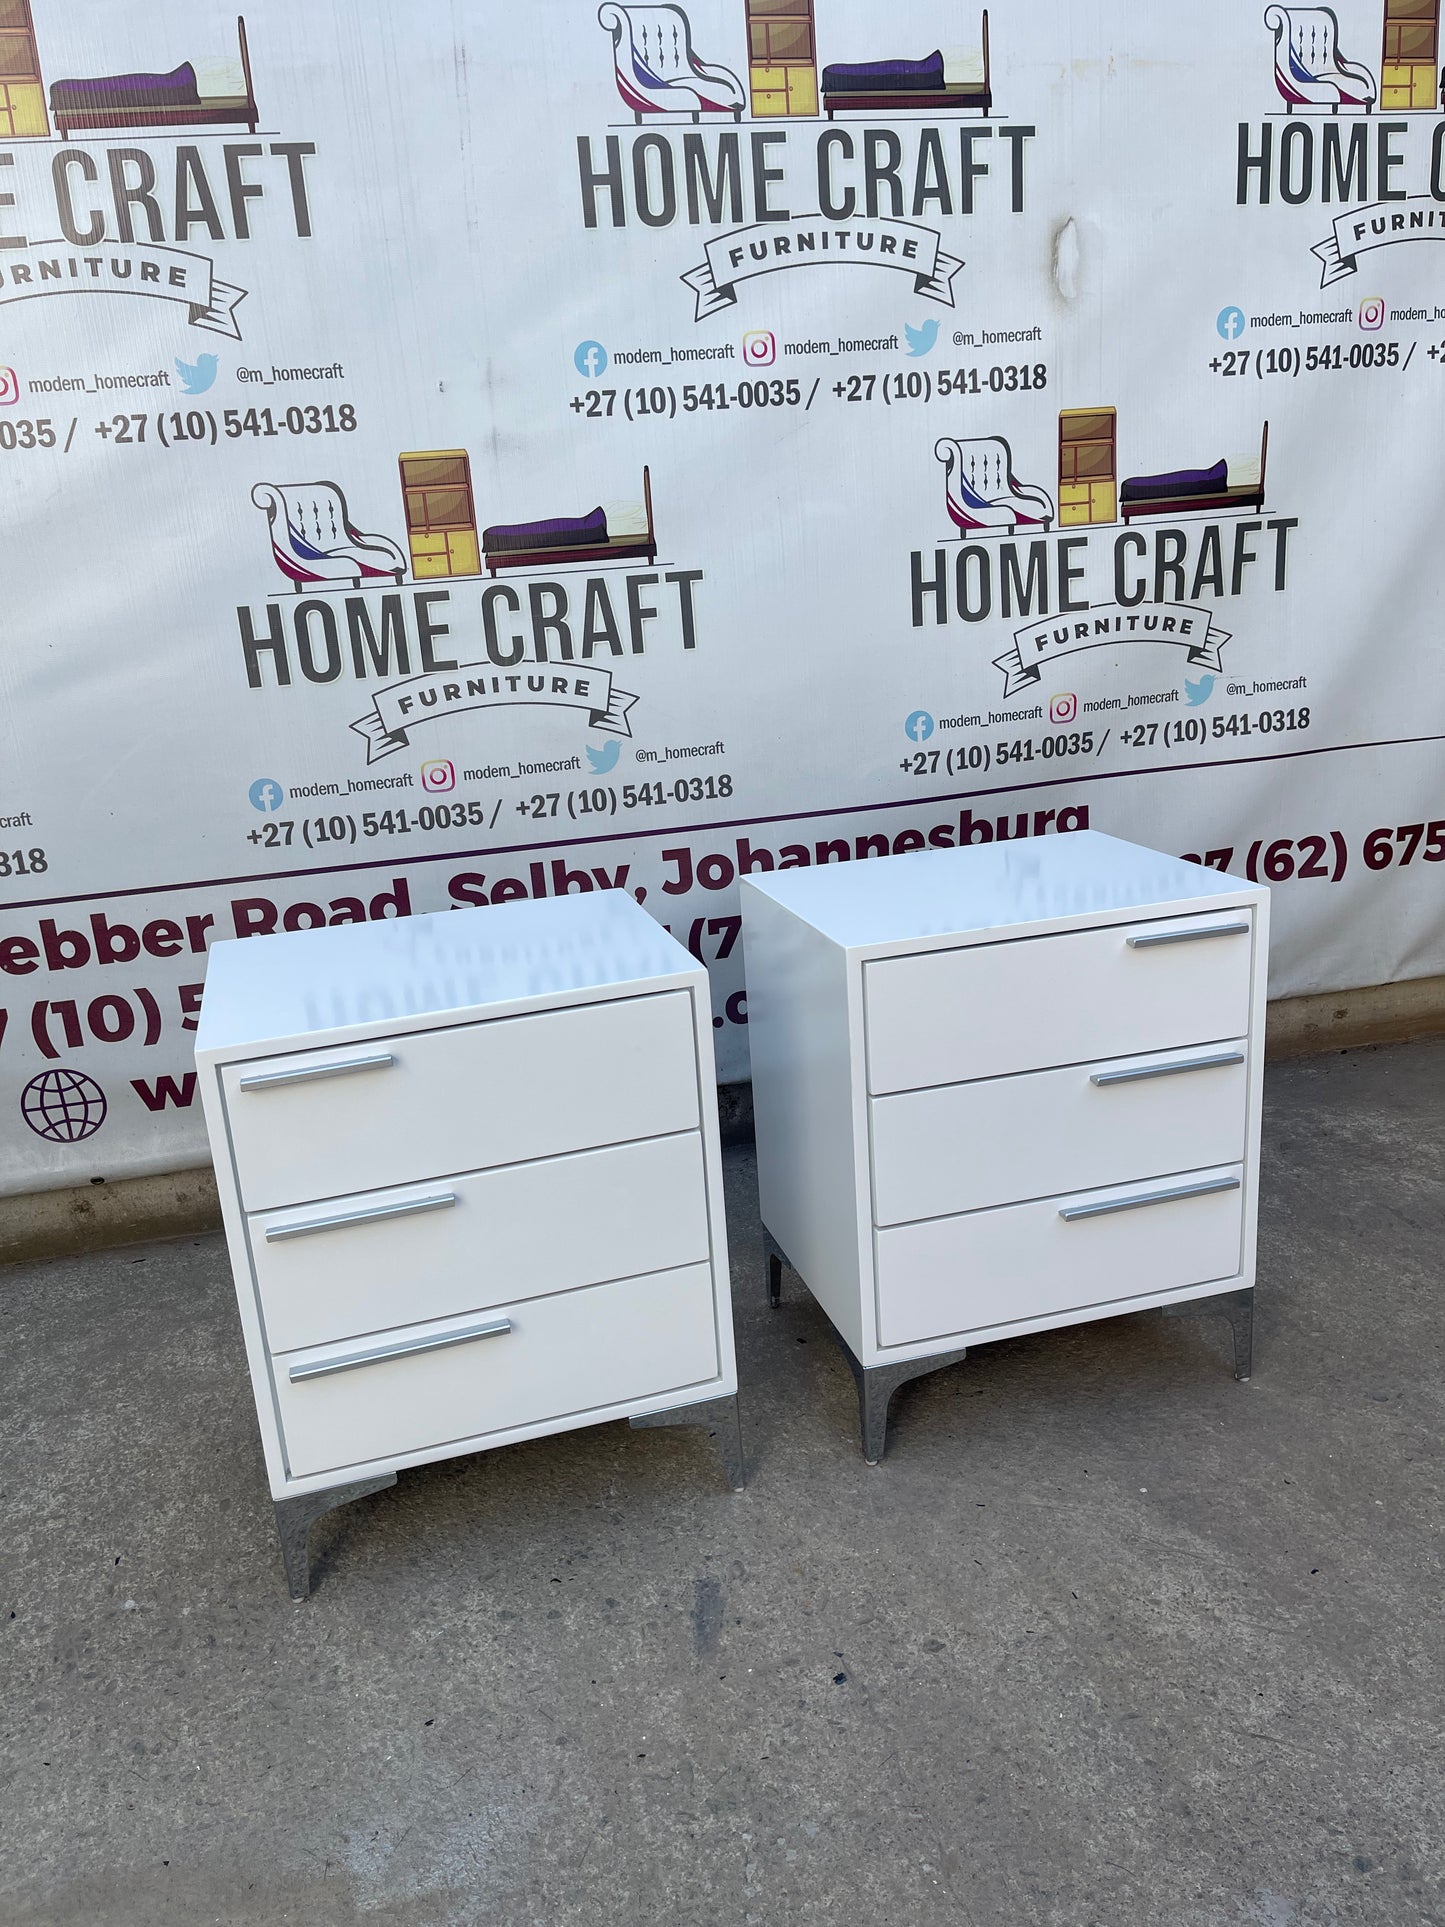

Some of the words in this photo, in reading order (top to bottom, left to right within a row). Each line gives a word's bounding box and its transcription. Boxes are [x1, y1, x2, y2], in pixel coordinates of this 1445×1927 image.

[576, 130, 791, 229] HOME
[816, 125, 1036, 221] CRAFT
[1236, 121, 1408, 205] HOME
[52, 142, 316, 247] CRAFT
[0, 258, 187, 288] RNITURE
[729, 231, 919, 268] FURNITURE
[613, 343, 735, 367] modern_homecraft
[784, 335, 899, 358] modern_homecraft
[952, 327, 1042, 348] @m_homecraft
[1250, 308, 1353, 328] modern_homecraft
[28, 371, 171, 394] modern_homecraft
[236, 363, 345, 385] @m_homecraft
[1208, 351, 1250, 377] +27
[1256, 347, 1300, 379] (10)
[1305, 342, 1399, 370] 541-0035
[569, 389, 616, 418] +27
[624, 386, 676, 421] (10)
[682, 378, 801, 412] 541-0035
[832, 374, 876, 402] +27
[883, 371, 931, 405] (10)
[937, 363, 1047, 396] 541-0318
[94, 414, 148, 443] +27
[157, 410, 218, 447] (10)
[224, 404, 357, 437] 541-0318
[910, 536, 1090, 628] HOME
[1113, 518, 1298, 608] CRAFT
[235, 590, 459, 689] HOME
[481, 569, 704, 668] CRAFT
[1035, 615, 1195, 652] FURNITURE
[397, 675, 591, 715] FURNITURE
[938, 705, 1043, 730] modern_homecraft
[1083, 689, 1180, 713] modern_homecraft
[1226, 675, 1308, 697] @m_homecraft
[289, 772, 414, 800] modern_homecraft
[463, 755, 581, 783] modern_homecraft
[635, 740, 725, 764] @m_homecraft
[899, 749, 940, 776] +27
[946, 744, 990, 775] (10)
[995, 731, 1094, 765] 541-0035
[1120, 722, 1159, 748] +27
[1164, 717, 1207, 749] (10)
[1211, 707, 1310, 739] 541-0318
[246, 820, 295, 849] +27
[303, 814, 357, 850] (10)
[363, 801, 484, 838] 541-0035
[515, 792, 561, 820] +27
[568, 787, 617, 820] (10)
[623, 774, 734, 808] 541-0318
[230, 877, 413, 939] Road
[31, 987, 162, 1059] (10)
[1246, 830, 1348, 883] (62)
